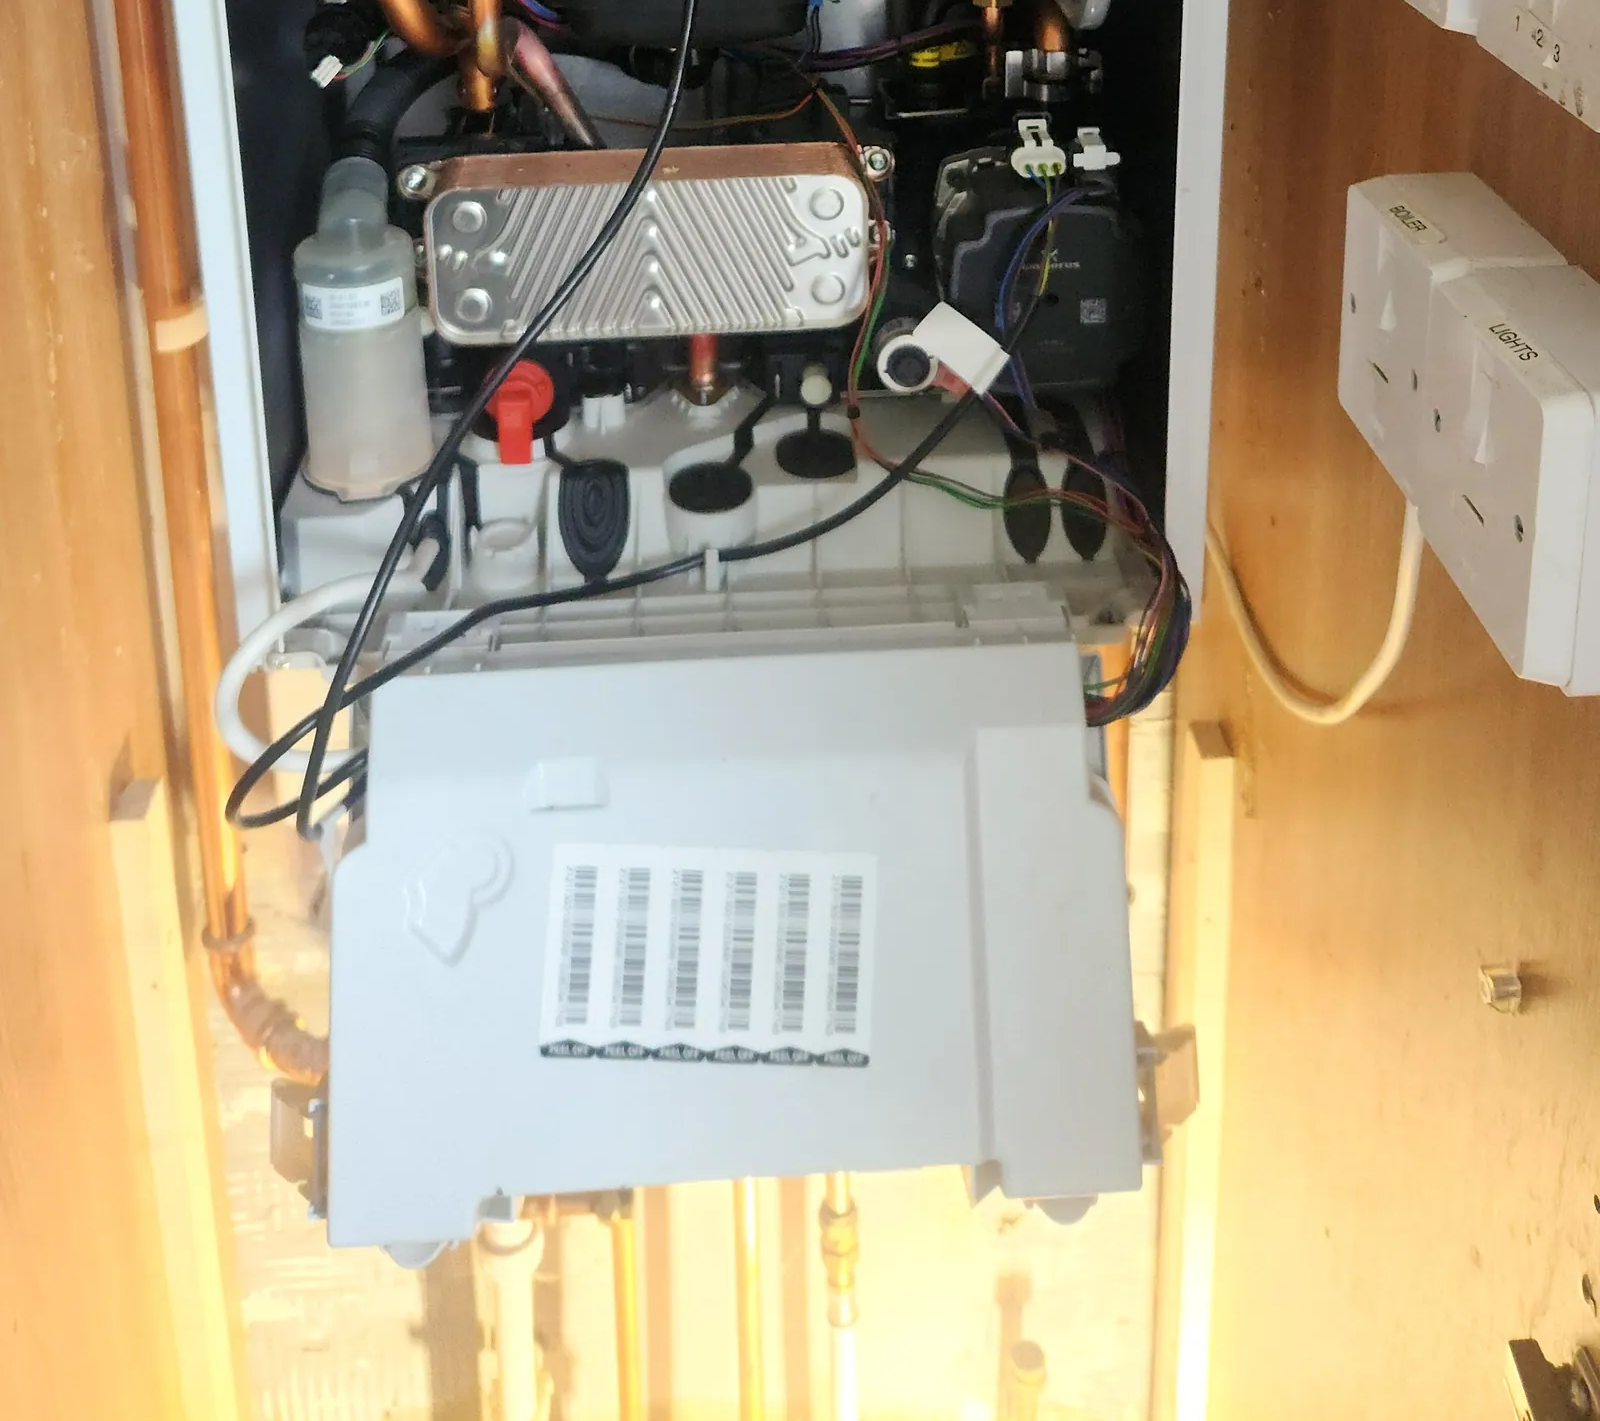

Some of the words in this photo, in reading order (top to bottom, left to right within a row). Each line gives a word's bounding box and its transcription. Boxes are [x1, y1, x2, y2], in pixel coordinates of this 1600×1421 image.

[1515, 15, 1521, 32] 1
[1536, 28, 1544, 48] 2
[1553, 43, 1561, 63] 3
[1389, 205, 1428, 231] BOILER
[1488, 323, 1539, 361] LIGHTS
